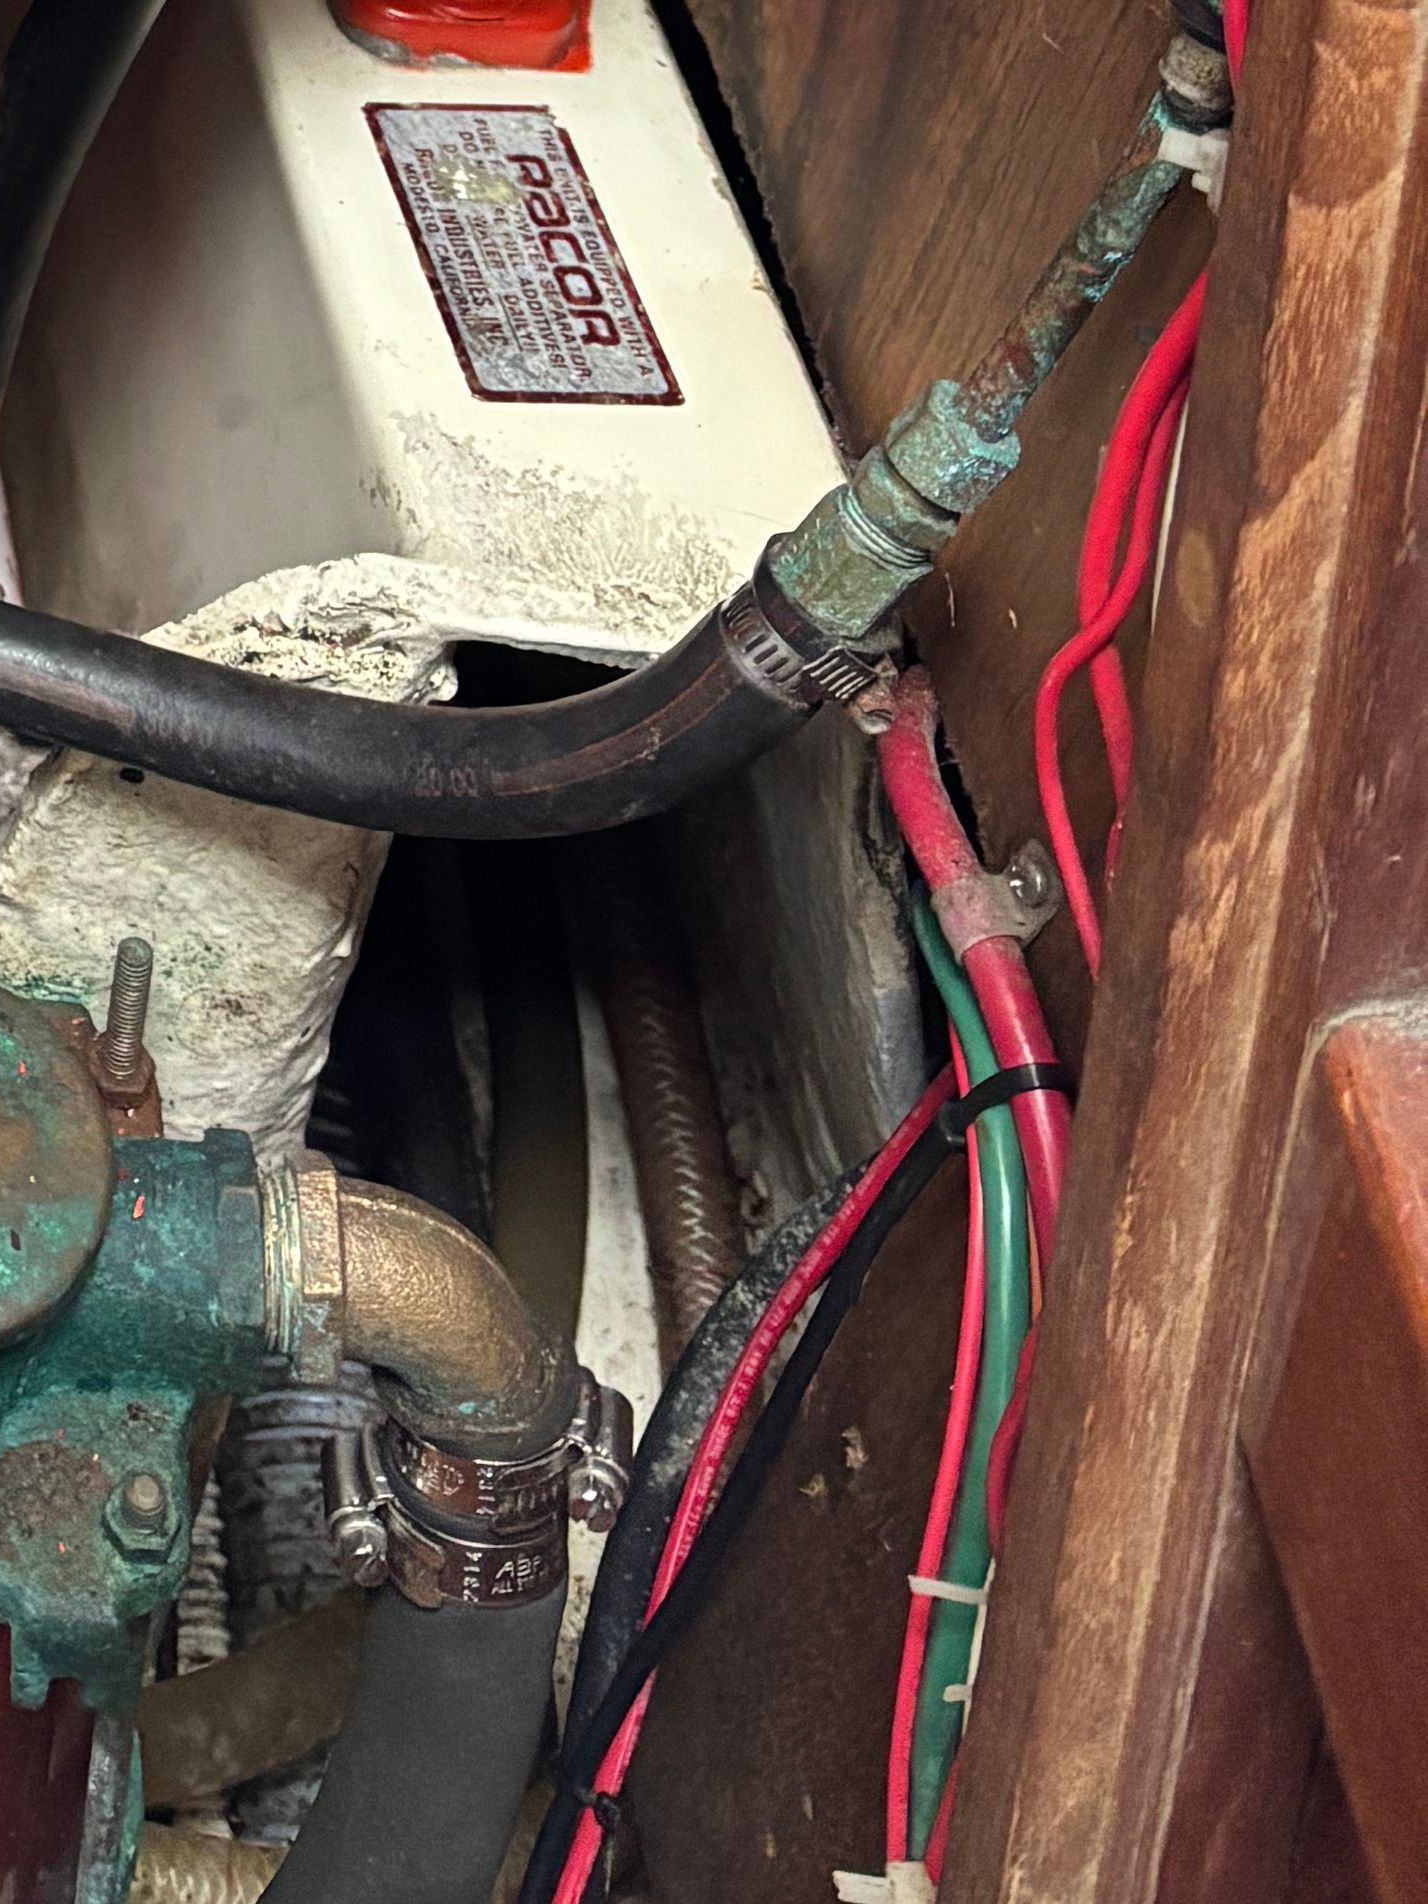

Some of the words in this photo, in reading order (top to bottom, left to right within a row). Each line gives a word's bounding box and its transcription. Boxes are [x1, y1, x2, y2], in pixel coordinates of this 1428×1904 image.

[467, 215, 506, 271] WATER
[536, 129, 565, 161] THIS
[616, 316, 647, 358] WITH
[637, 364, 655, 376] A
